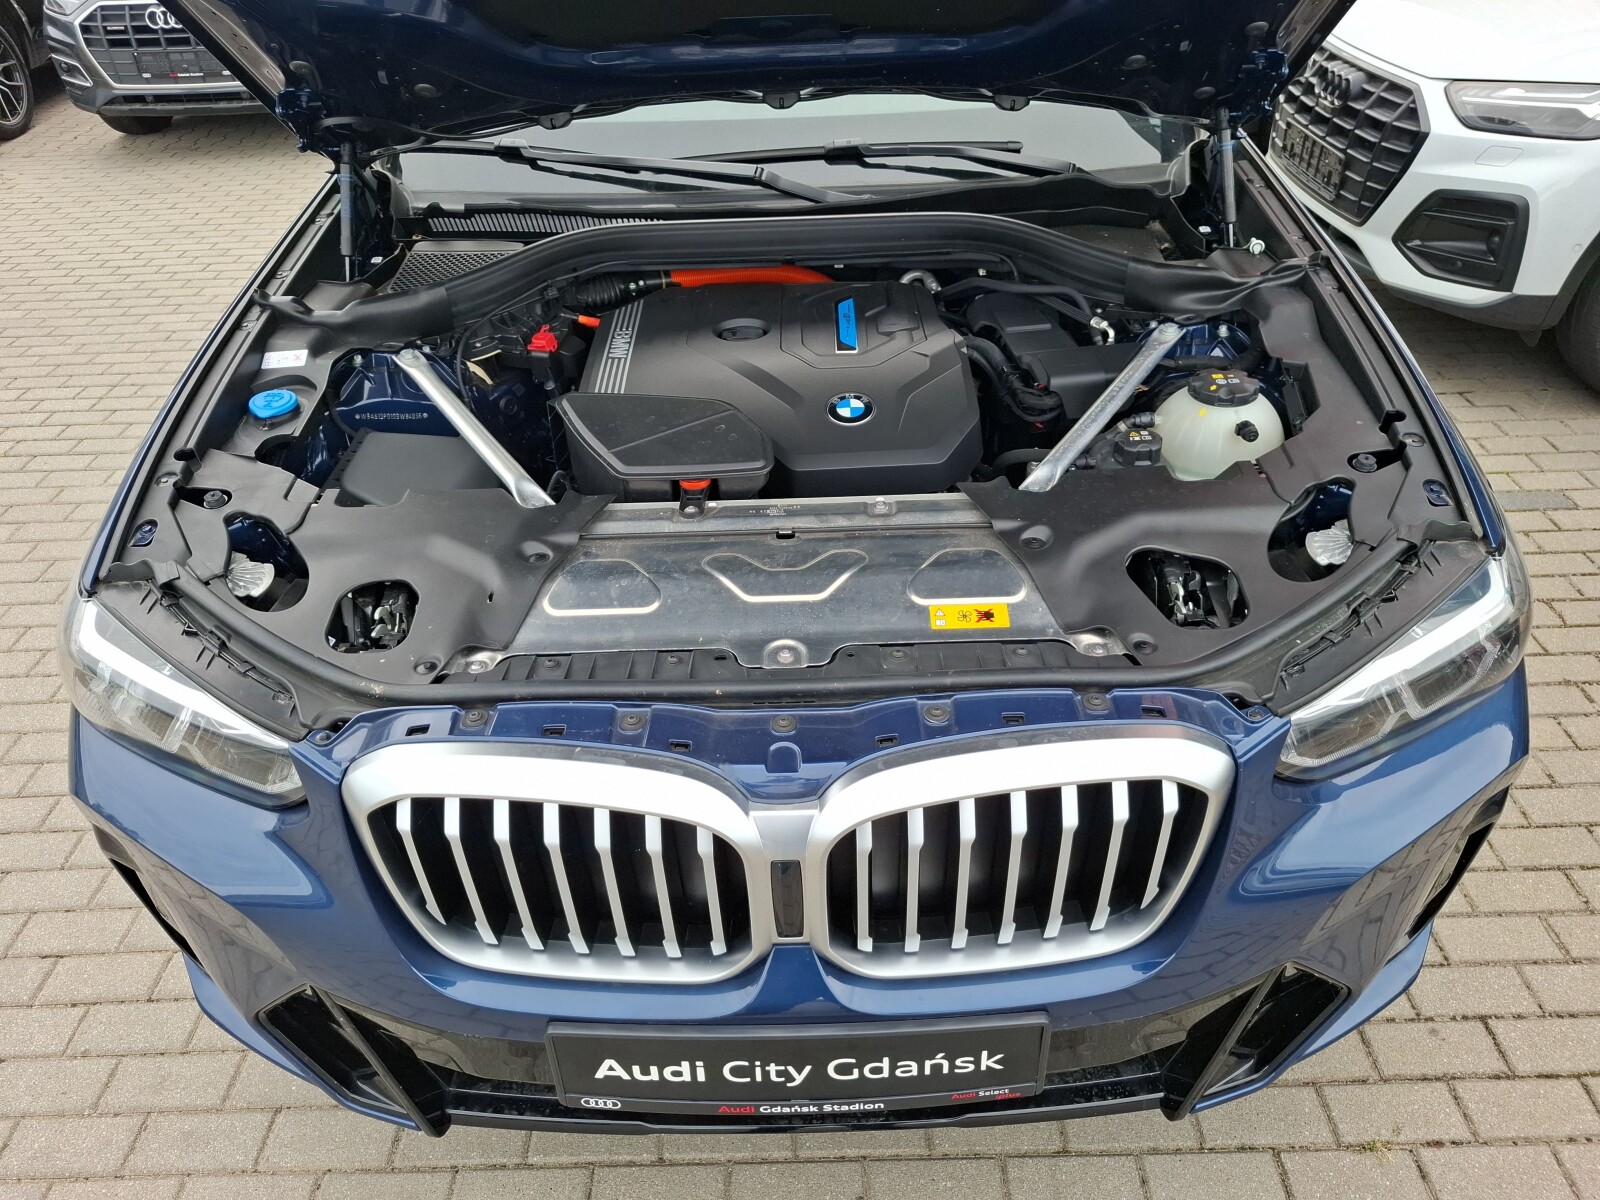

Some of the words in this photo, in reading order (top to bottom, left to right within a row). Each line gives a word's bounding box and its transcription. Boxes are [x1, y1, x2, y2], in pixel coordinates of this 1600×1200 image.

[608, 330, 633, 358] BMW
[594, 1058, 706, 1082] Audi
[722, 1060, 812, 1087] City
[826, 1050, 1006, 1081] Gdańsk
[978, 1088, 1010, 1097] Select
[719, 1105, 755, 1113] Audi
[759, 1104, 819, 1113] Gdańsk
[822, 1101, 885, 1112] Stadion
